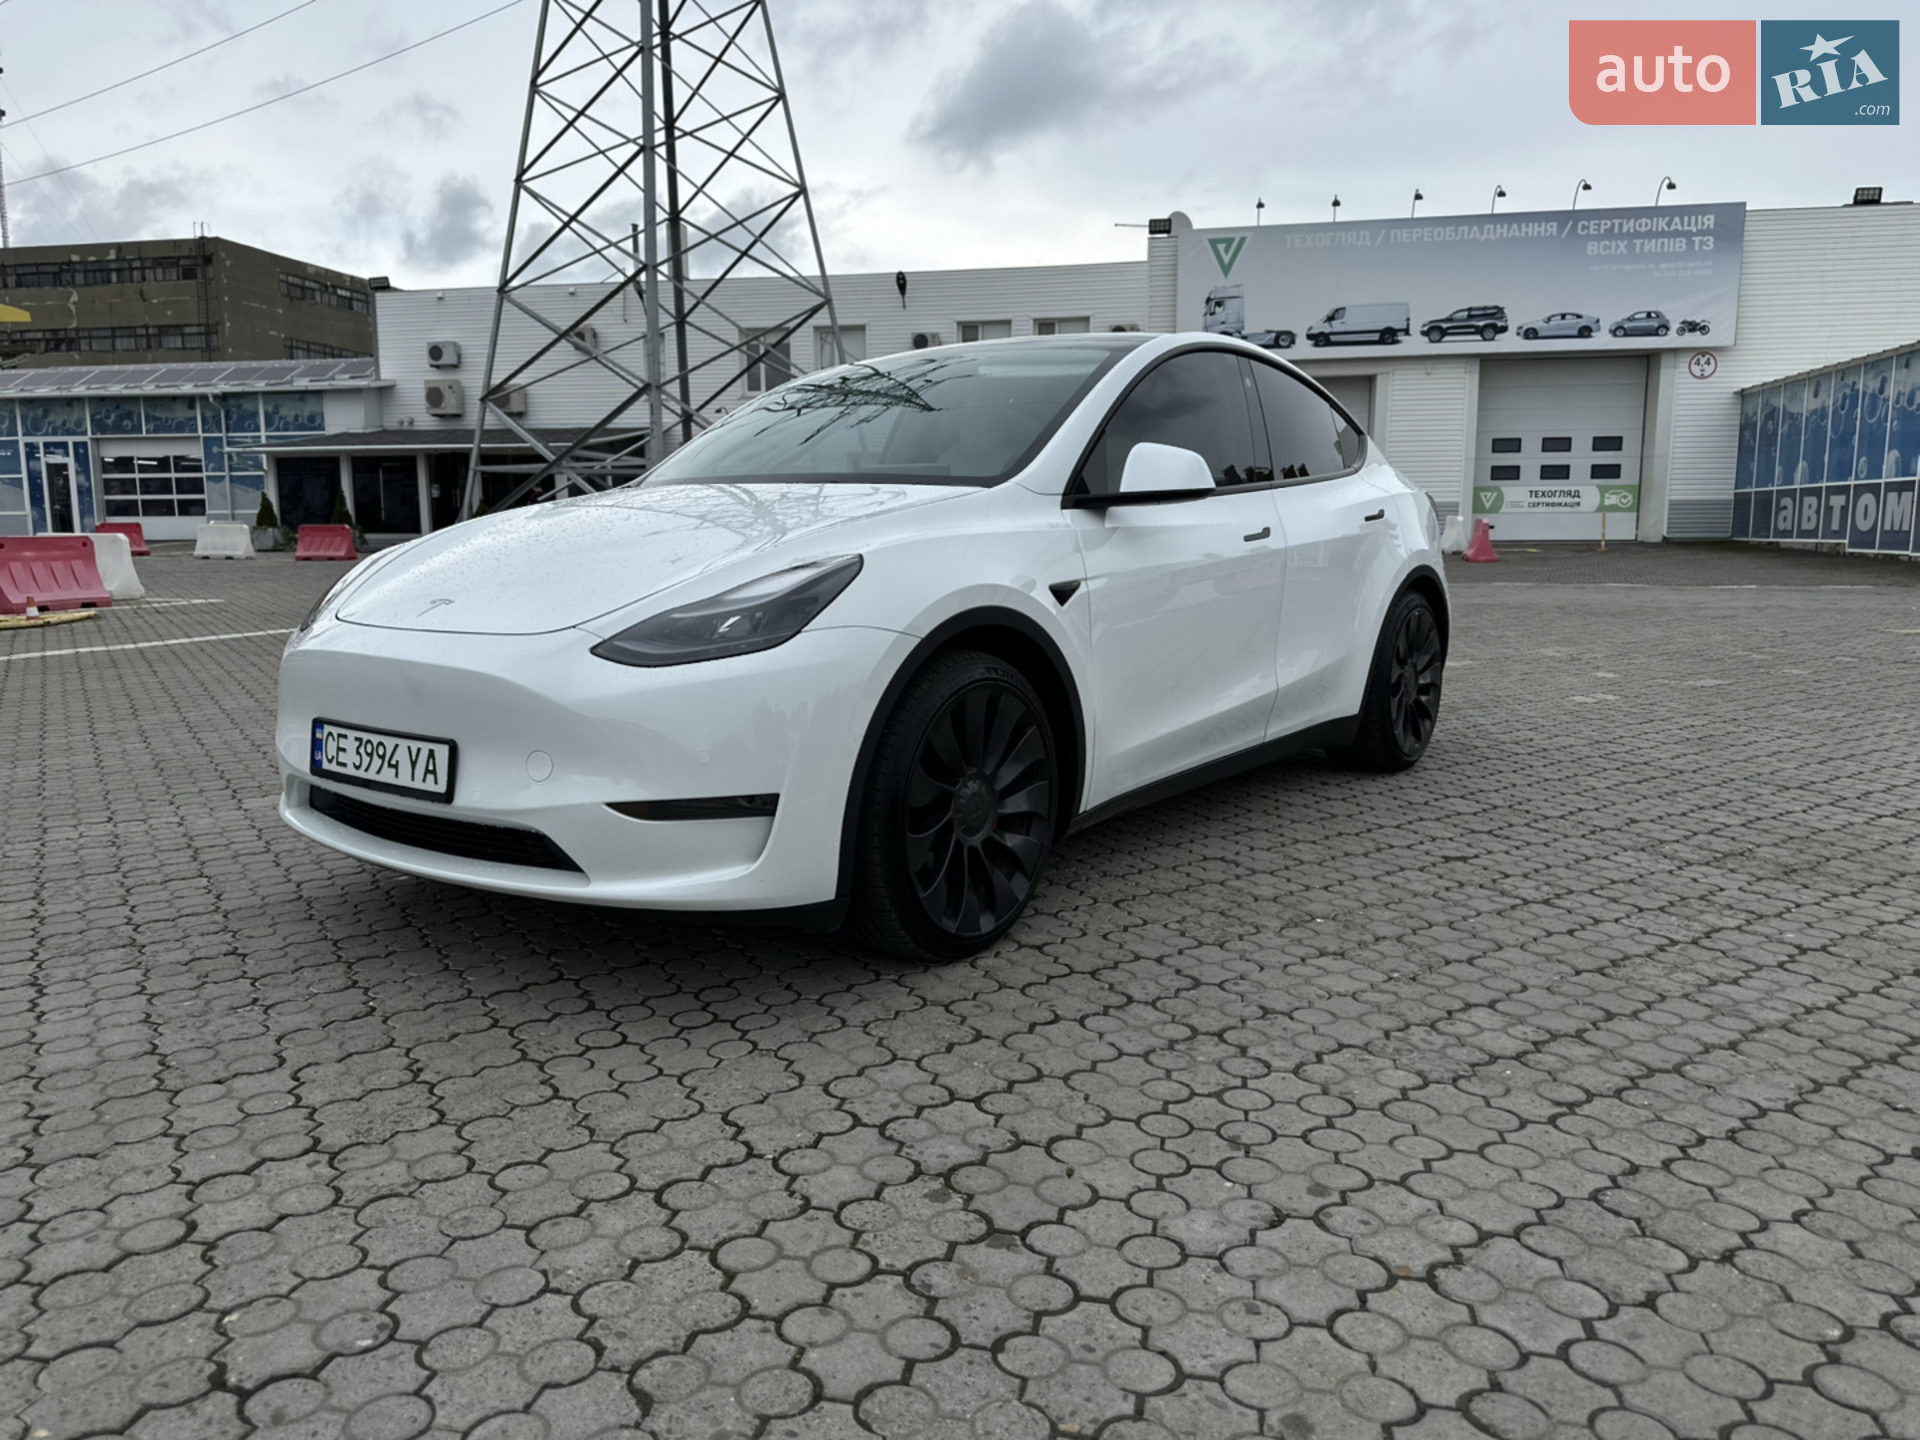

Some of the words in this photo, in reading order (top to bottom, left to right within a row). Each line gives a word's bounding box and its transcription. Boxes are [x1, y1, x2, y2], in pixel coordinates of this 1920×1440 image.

[1284, 230, 1371, 249] ТЕХОГЛЯД
[1389, 221, 1558, 244] ПЕРЕОБЛАДНАННЯ
[1577, 214, 1715, 236] СЕРТИФІКАЦІЯ
[1587, 240, 1628, 256] ВСІХ
[1633, 237, 1687, 254] ТИПІВ
[1528, 489, 1581, 500] ТЕХОГЛЯД
[1527, 501, 1581, 509] СЕРТИФІКАЦІЯ
[324, 731, 348, 768] CE
[352, 736, 400, 779] 3994
[407, 745, 439, 786] YA
